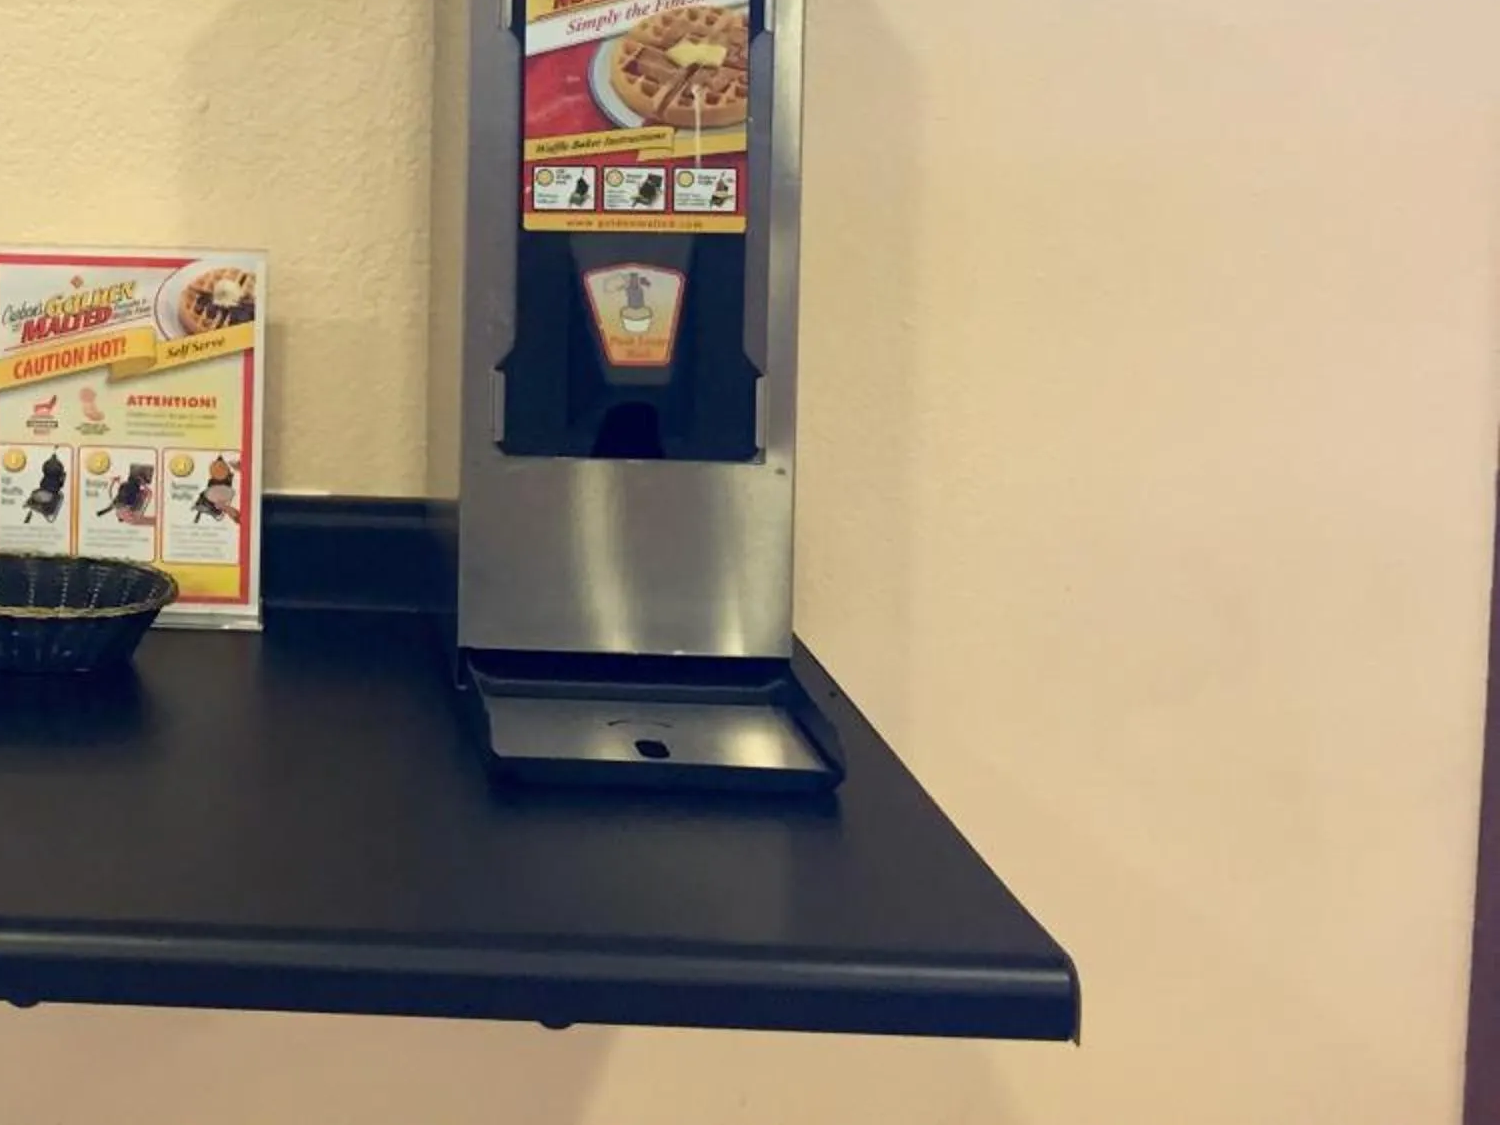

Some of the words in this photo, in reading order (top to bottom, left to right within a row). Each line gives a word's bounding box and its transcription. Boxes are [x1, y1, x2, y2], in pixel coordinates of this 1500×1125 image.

[566, 9, 620, 35] Simply
[625, 1, 651, 19] the
[44, 280, 137, 316] GOLDEN
[20, 306, 113, 343] MALTED
[13, 344, 88, 380] CAUTION
[88, 336, 127, 362] HOT!
[167, 342, 190, 360] Self
[192, 336, 226, 353] Serve
[126, 395, 217, 409] ATTENTION!
